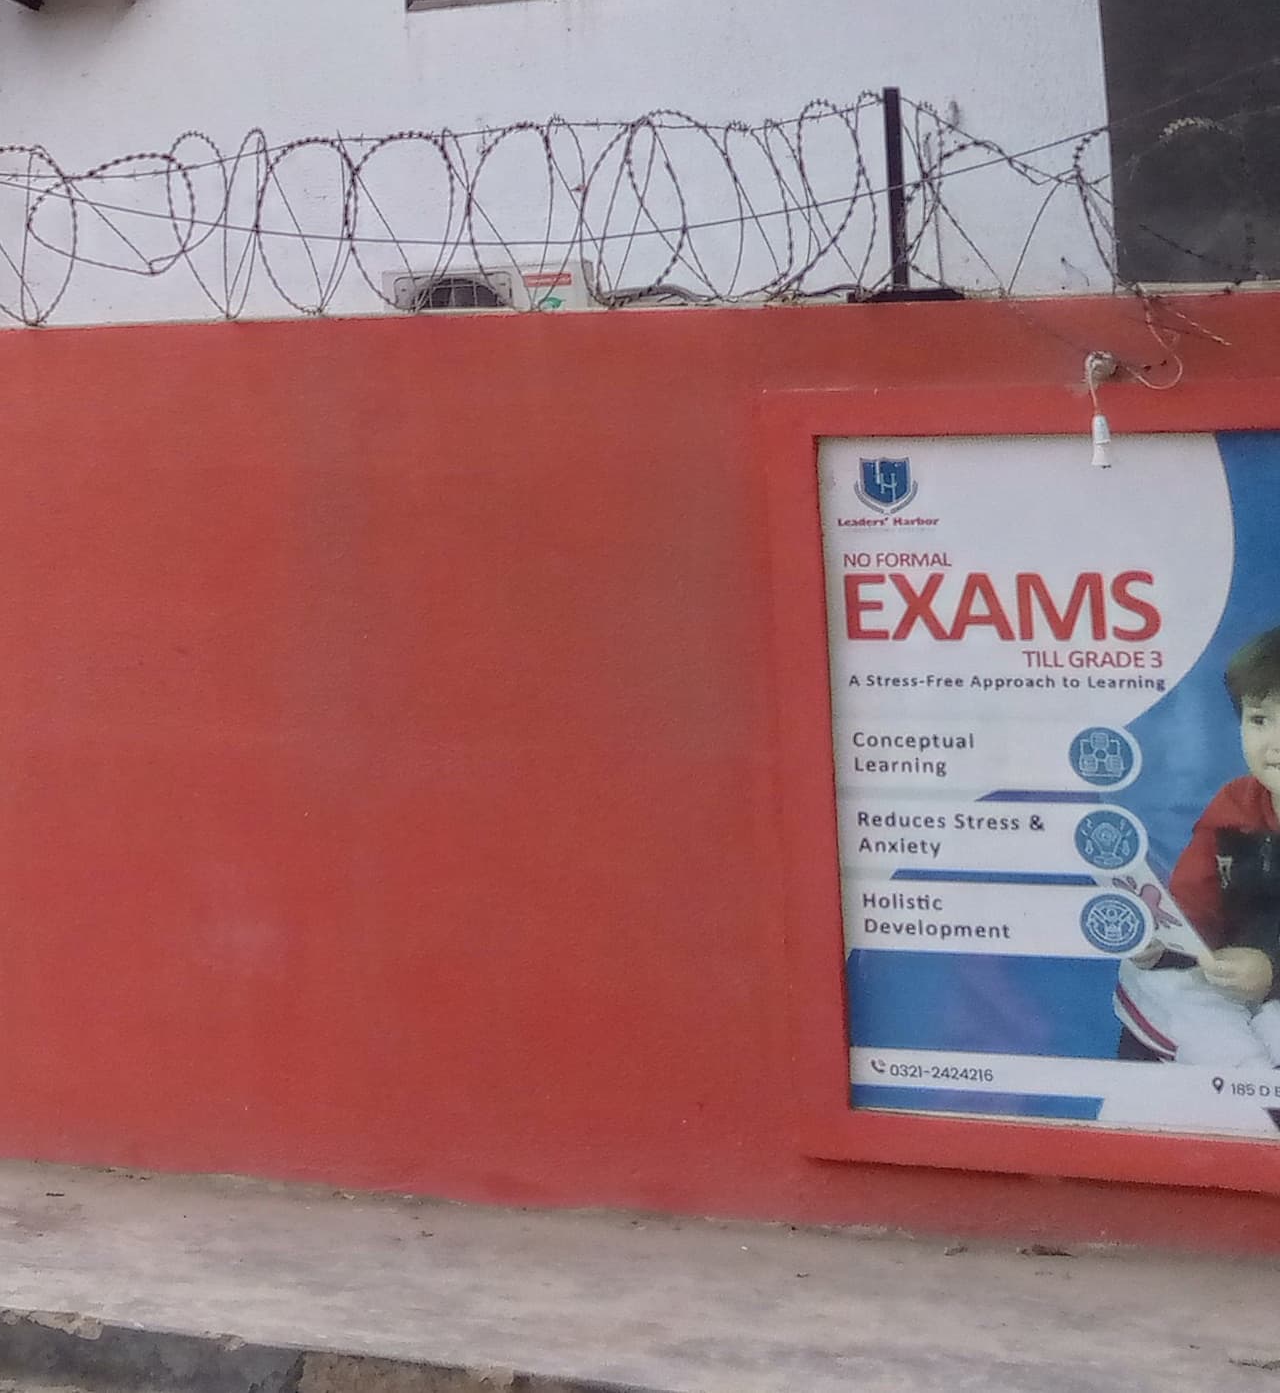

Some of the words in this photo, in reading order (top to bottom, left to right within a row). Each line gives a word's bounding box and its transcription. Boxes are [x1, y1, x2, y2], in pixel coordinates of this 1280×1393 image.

[837, 517, 889, 527] Leaders'
[893, 517, 940, 526] Harbor
[843, 552, 871, 568] NO
[877, 552, 952, 567] FORMAL
[843, 570, 1162, 642] EXAMS
[1022, 650, 1064, 669] TILL
[1068, 650, 1145, 669] GRADE
[1151, 651, 1163, 669] 3
[848, 674, 860, 688] A
[866, 674, 964, 688] Stress-Free
[970, 675, 1056, 691] Approach
[1062, 676, 1080, 689] to
[1088, 676, 1166, 692] Learning
[852, 731, 975, 752] Conceptual
[854, 757, 947, 778] Learning
[856, 810, 946, 829] Reduces
[954, 813, 1020, 831] Stress
[1029, 814, 1045, 831] &
[858, 837, 941, 858] Anxiety
[862, 893, 943, 911] Holistic
[864, 918, 1011, 940] Development
[889, 1064, 994, 1082] 0321-2424216
[1231, 1082, 1256, 1096] 185
[1259, 1085, 1270, 1097] D
